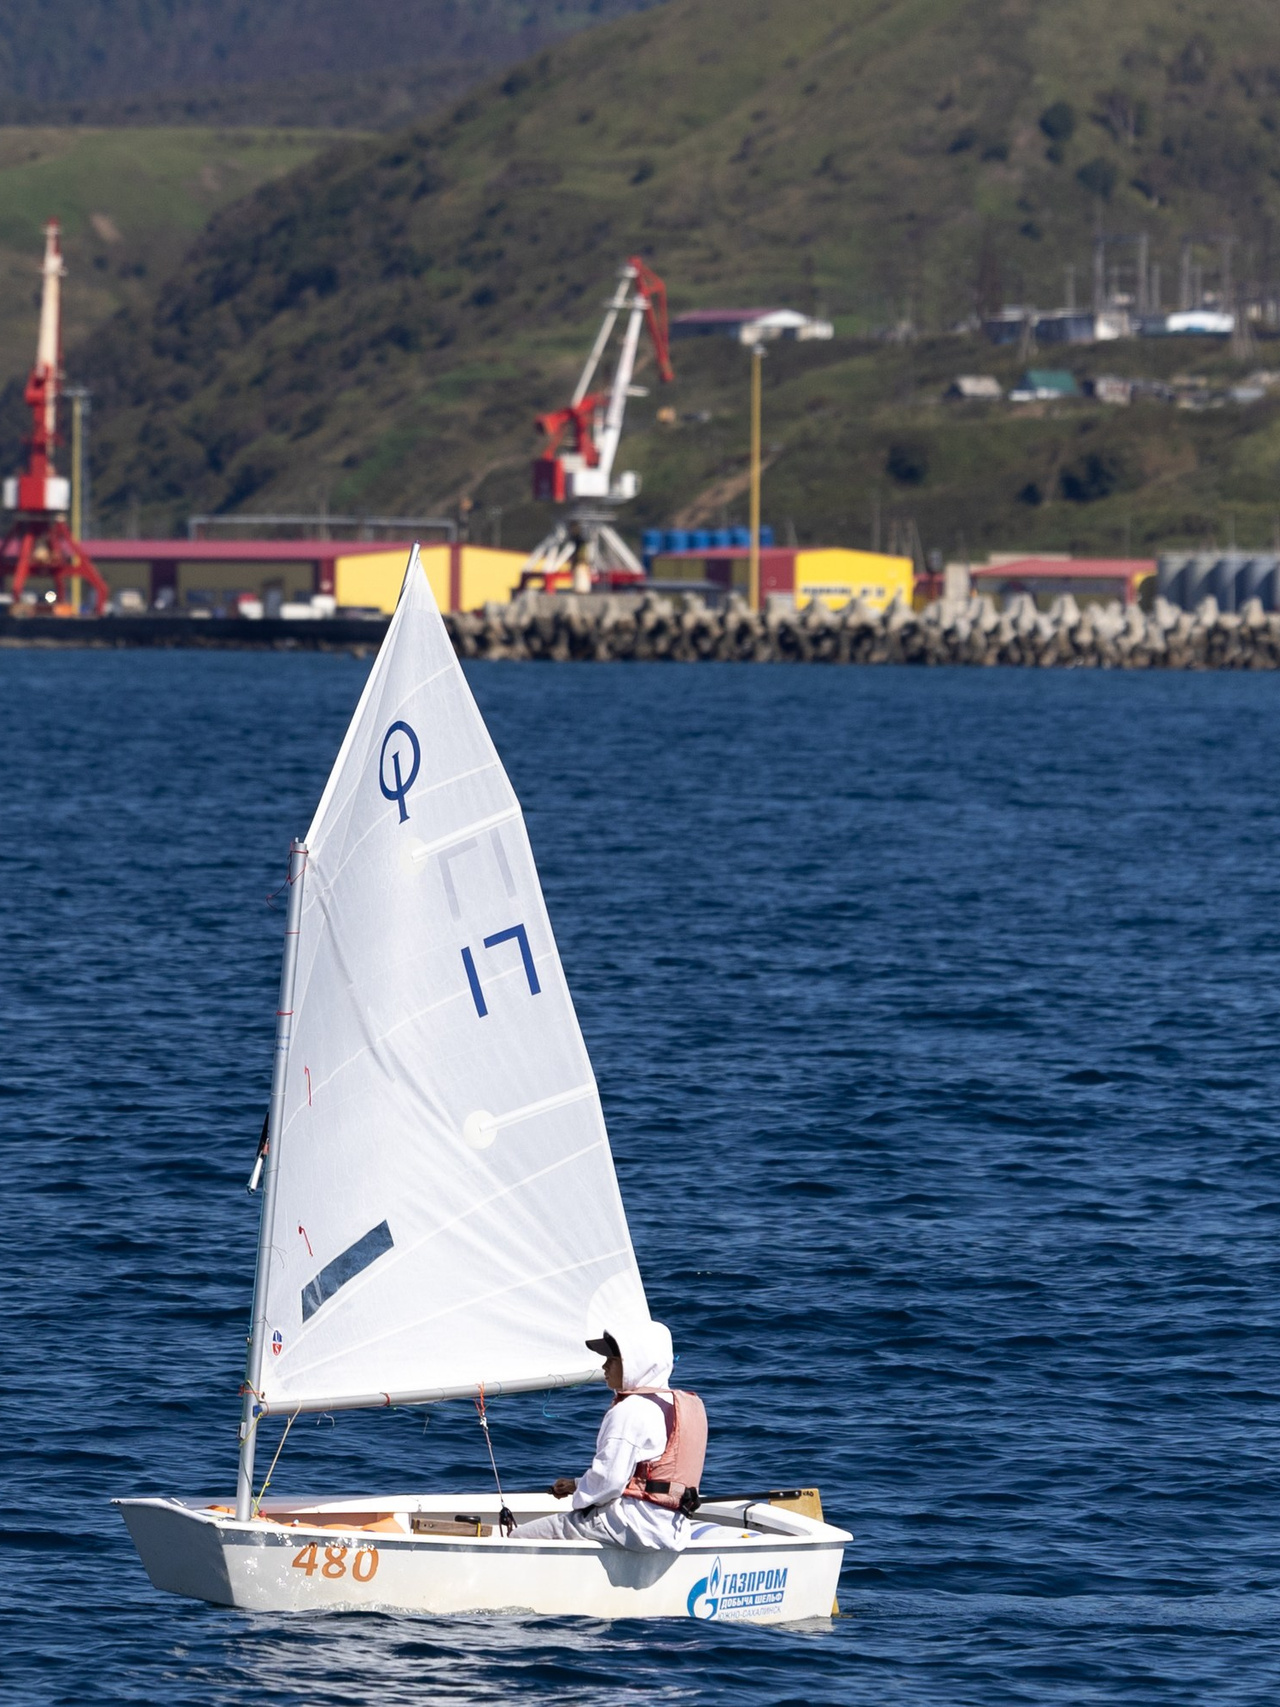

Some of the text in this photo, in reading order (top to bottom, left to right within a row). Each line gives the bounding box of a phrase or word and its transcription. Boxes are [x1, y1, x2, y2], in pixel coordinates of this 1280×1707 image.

[461, 923, 541, 1018] 17
[292, 1542, 379, 1582] 480
[722, 1567, 788, 1595] ГАЗПРОМ
[718, 1605, 782, 1619] ЮЖНО-САХАЛИНСК
[721, 1592, 782, 1609] ДОБЫЧА ШЕЛЬФ
